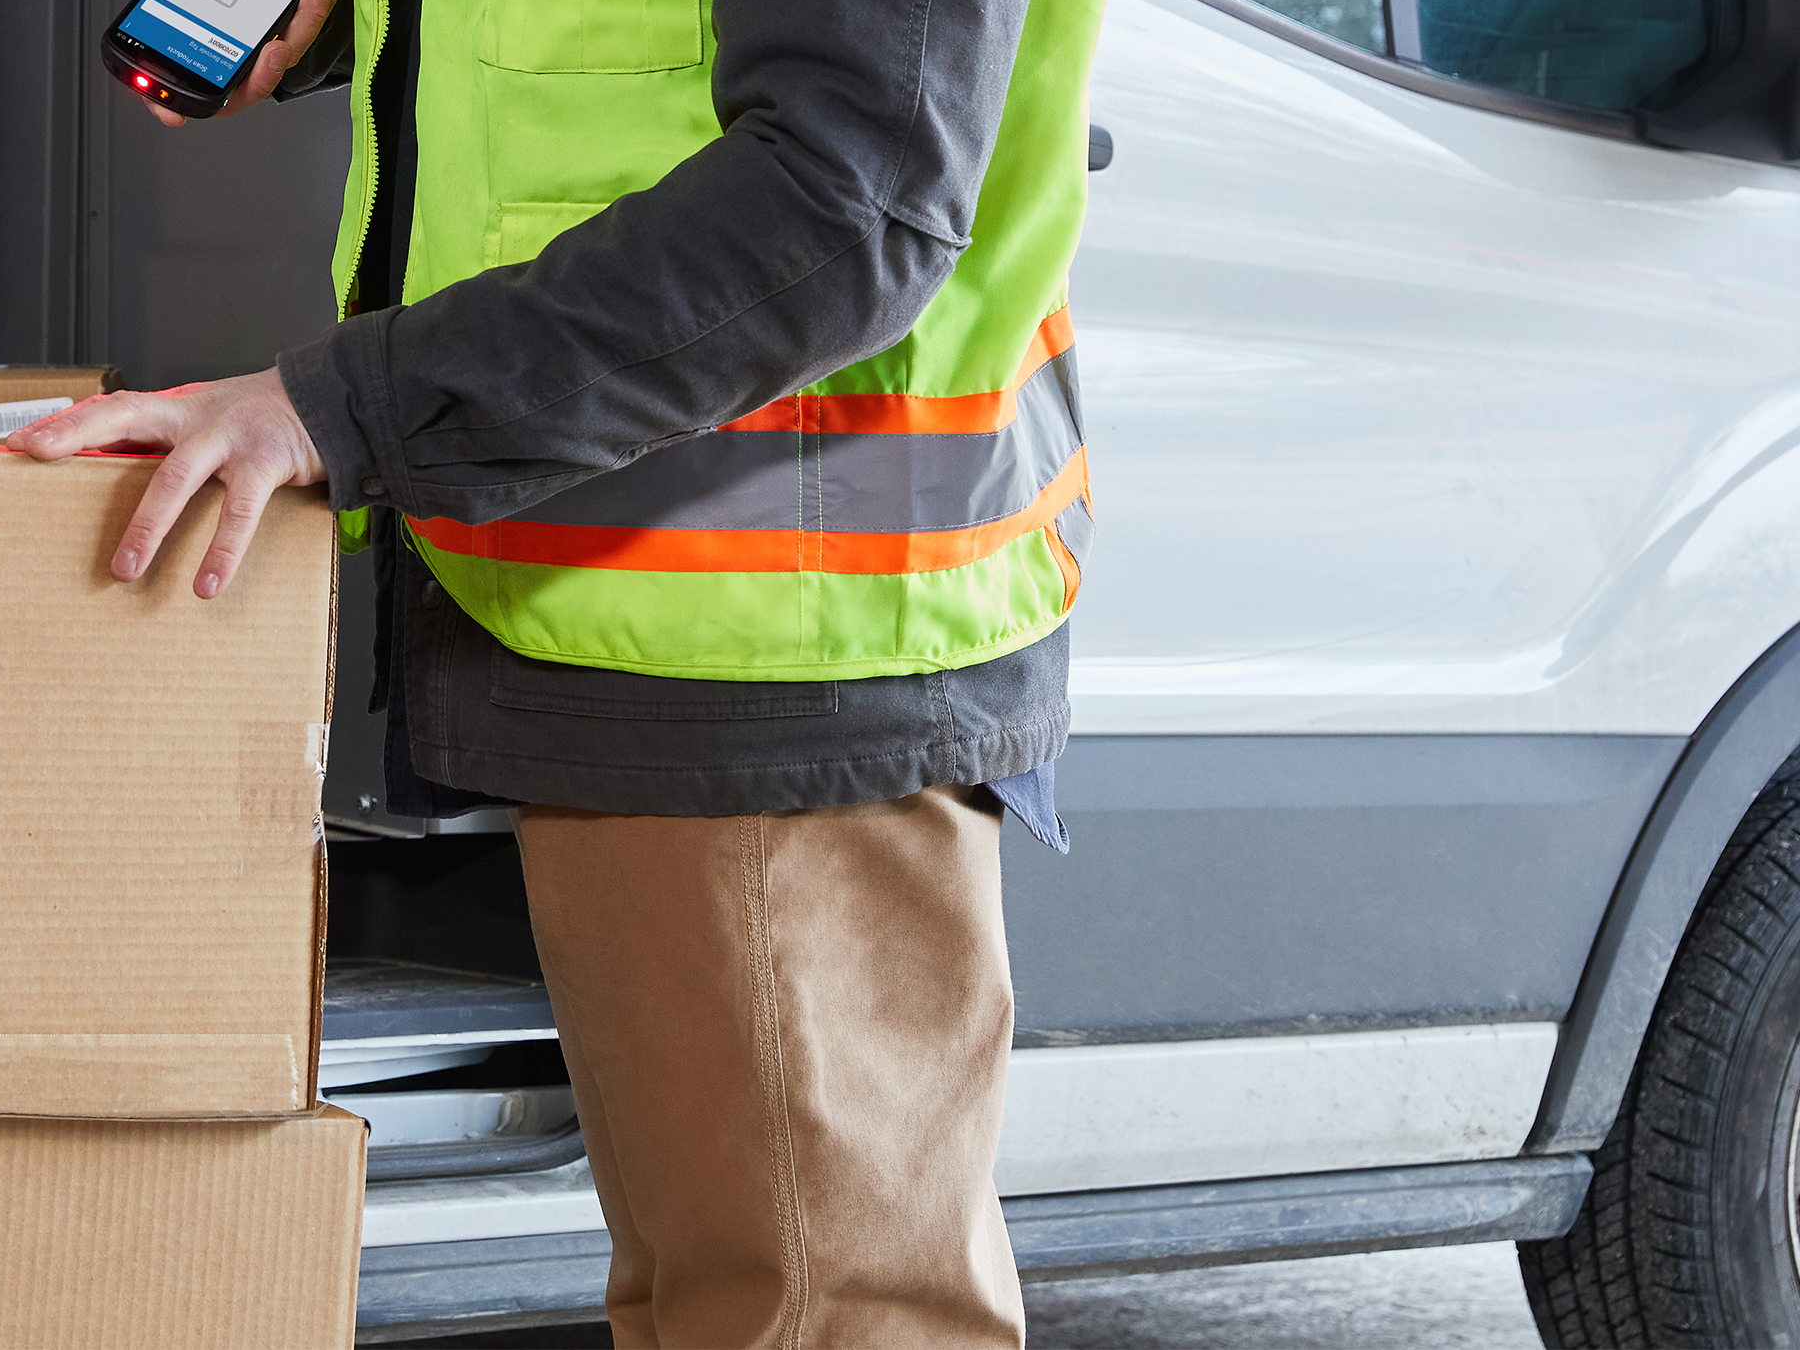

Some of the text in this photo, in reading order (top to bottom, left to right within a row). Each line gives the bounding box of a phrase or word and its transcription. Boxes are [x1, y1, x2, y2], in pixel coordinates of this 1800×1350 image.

[166, 45, 209, 73] Scan Products
[189, 40, 234, 71] Scan Barcode Tag
